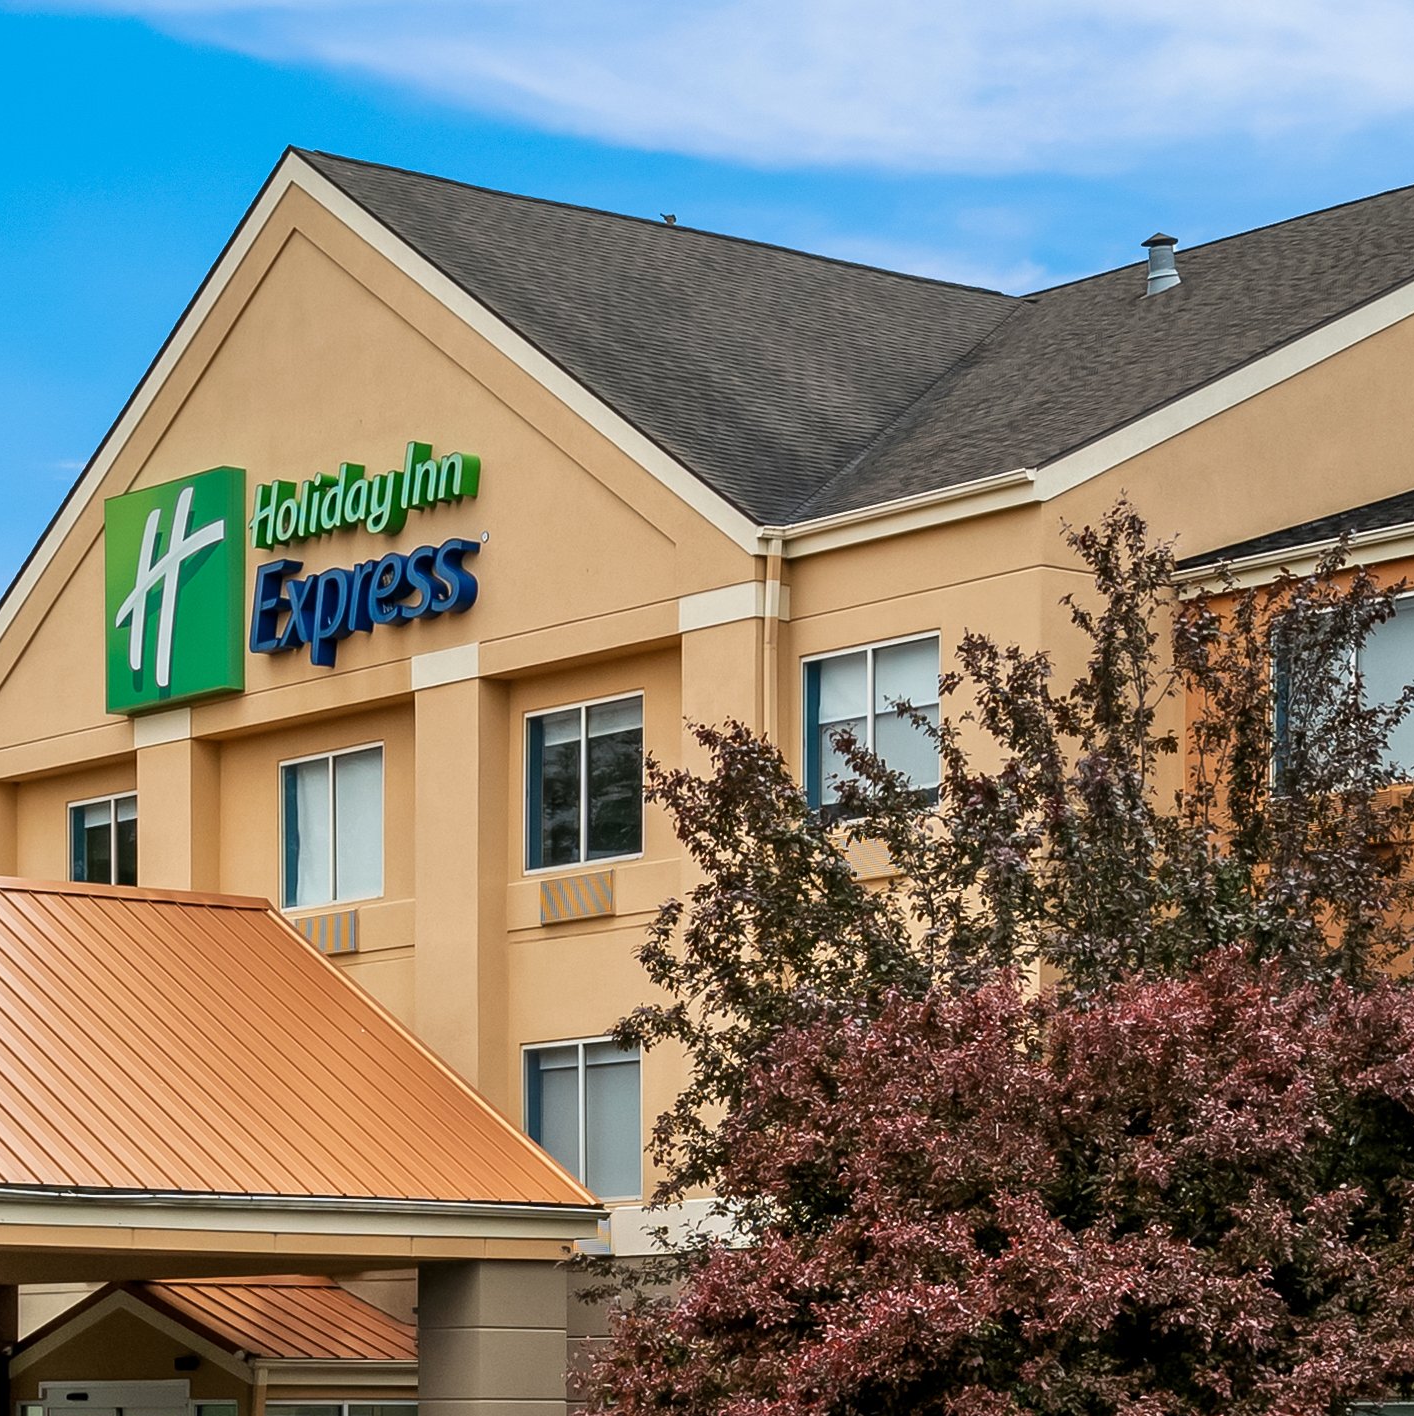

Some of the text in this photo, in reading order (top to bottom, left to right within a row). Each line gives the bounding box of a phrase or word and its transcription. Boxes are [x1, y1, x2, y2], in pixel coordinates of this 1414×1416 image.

[249, 441, 481, 550] Holiday Inn
[249, 538, 481, 668] Express
